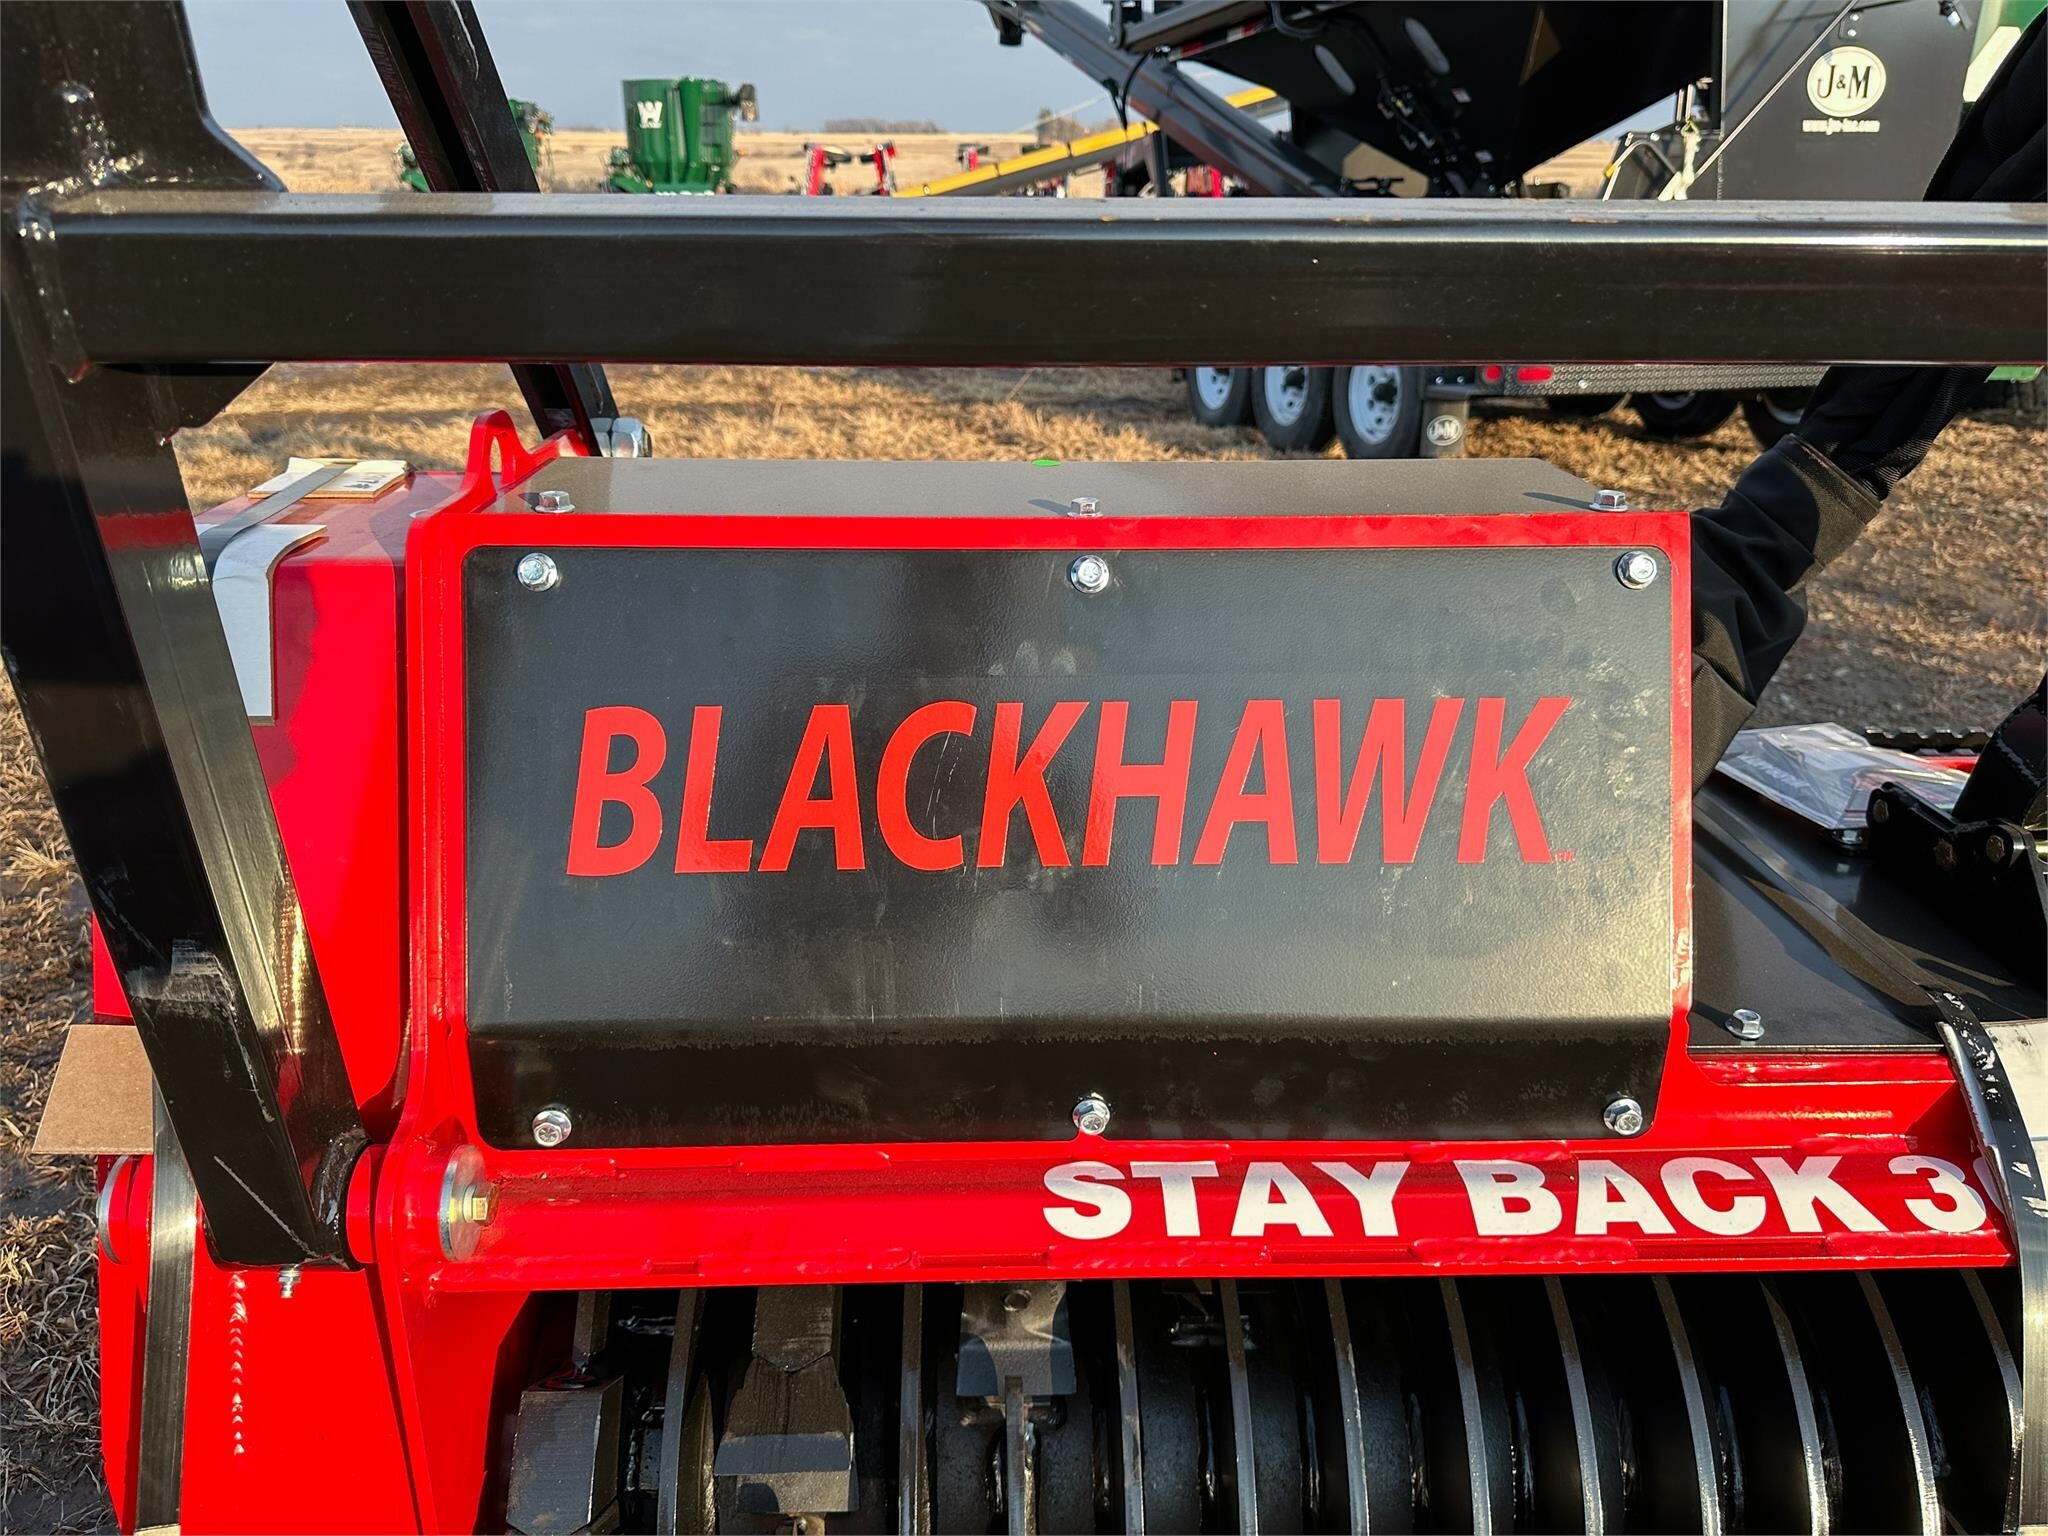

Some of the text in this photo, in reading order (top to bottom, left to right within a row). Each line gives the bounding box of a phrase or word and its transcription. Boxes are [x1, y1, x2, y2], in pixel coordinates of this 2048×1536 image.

[1817, 65, 1872, 99] J&M
[567, 696, 1571, 877] BLACKHAWK
[1042, 1160, 1410, 1240] STAY
[1452, 1155, 1890, 1237] BACK
